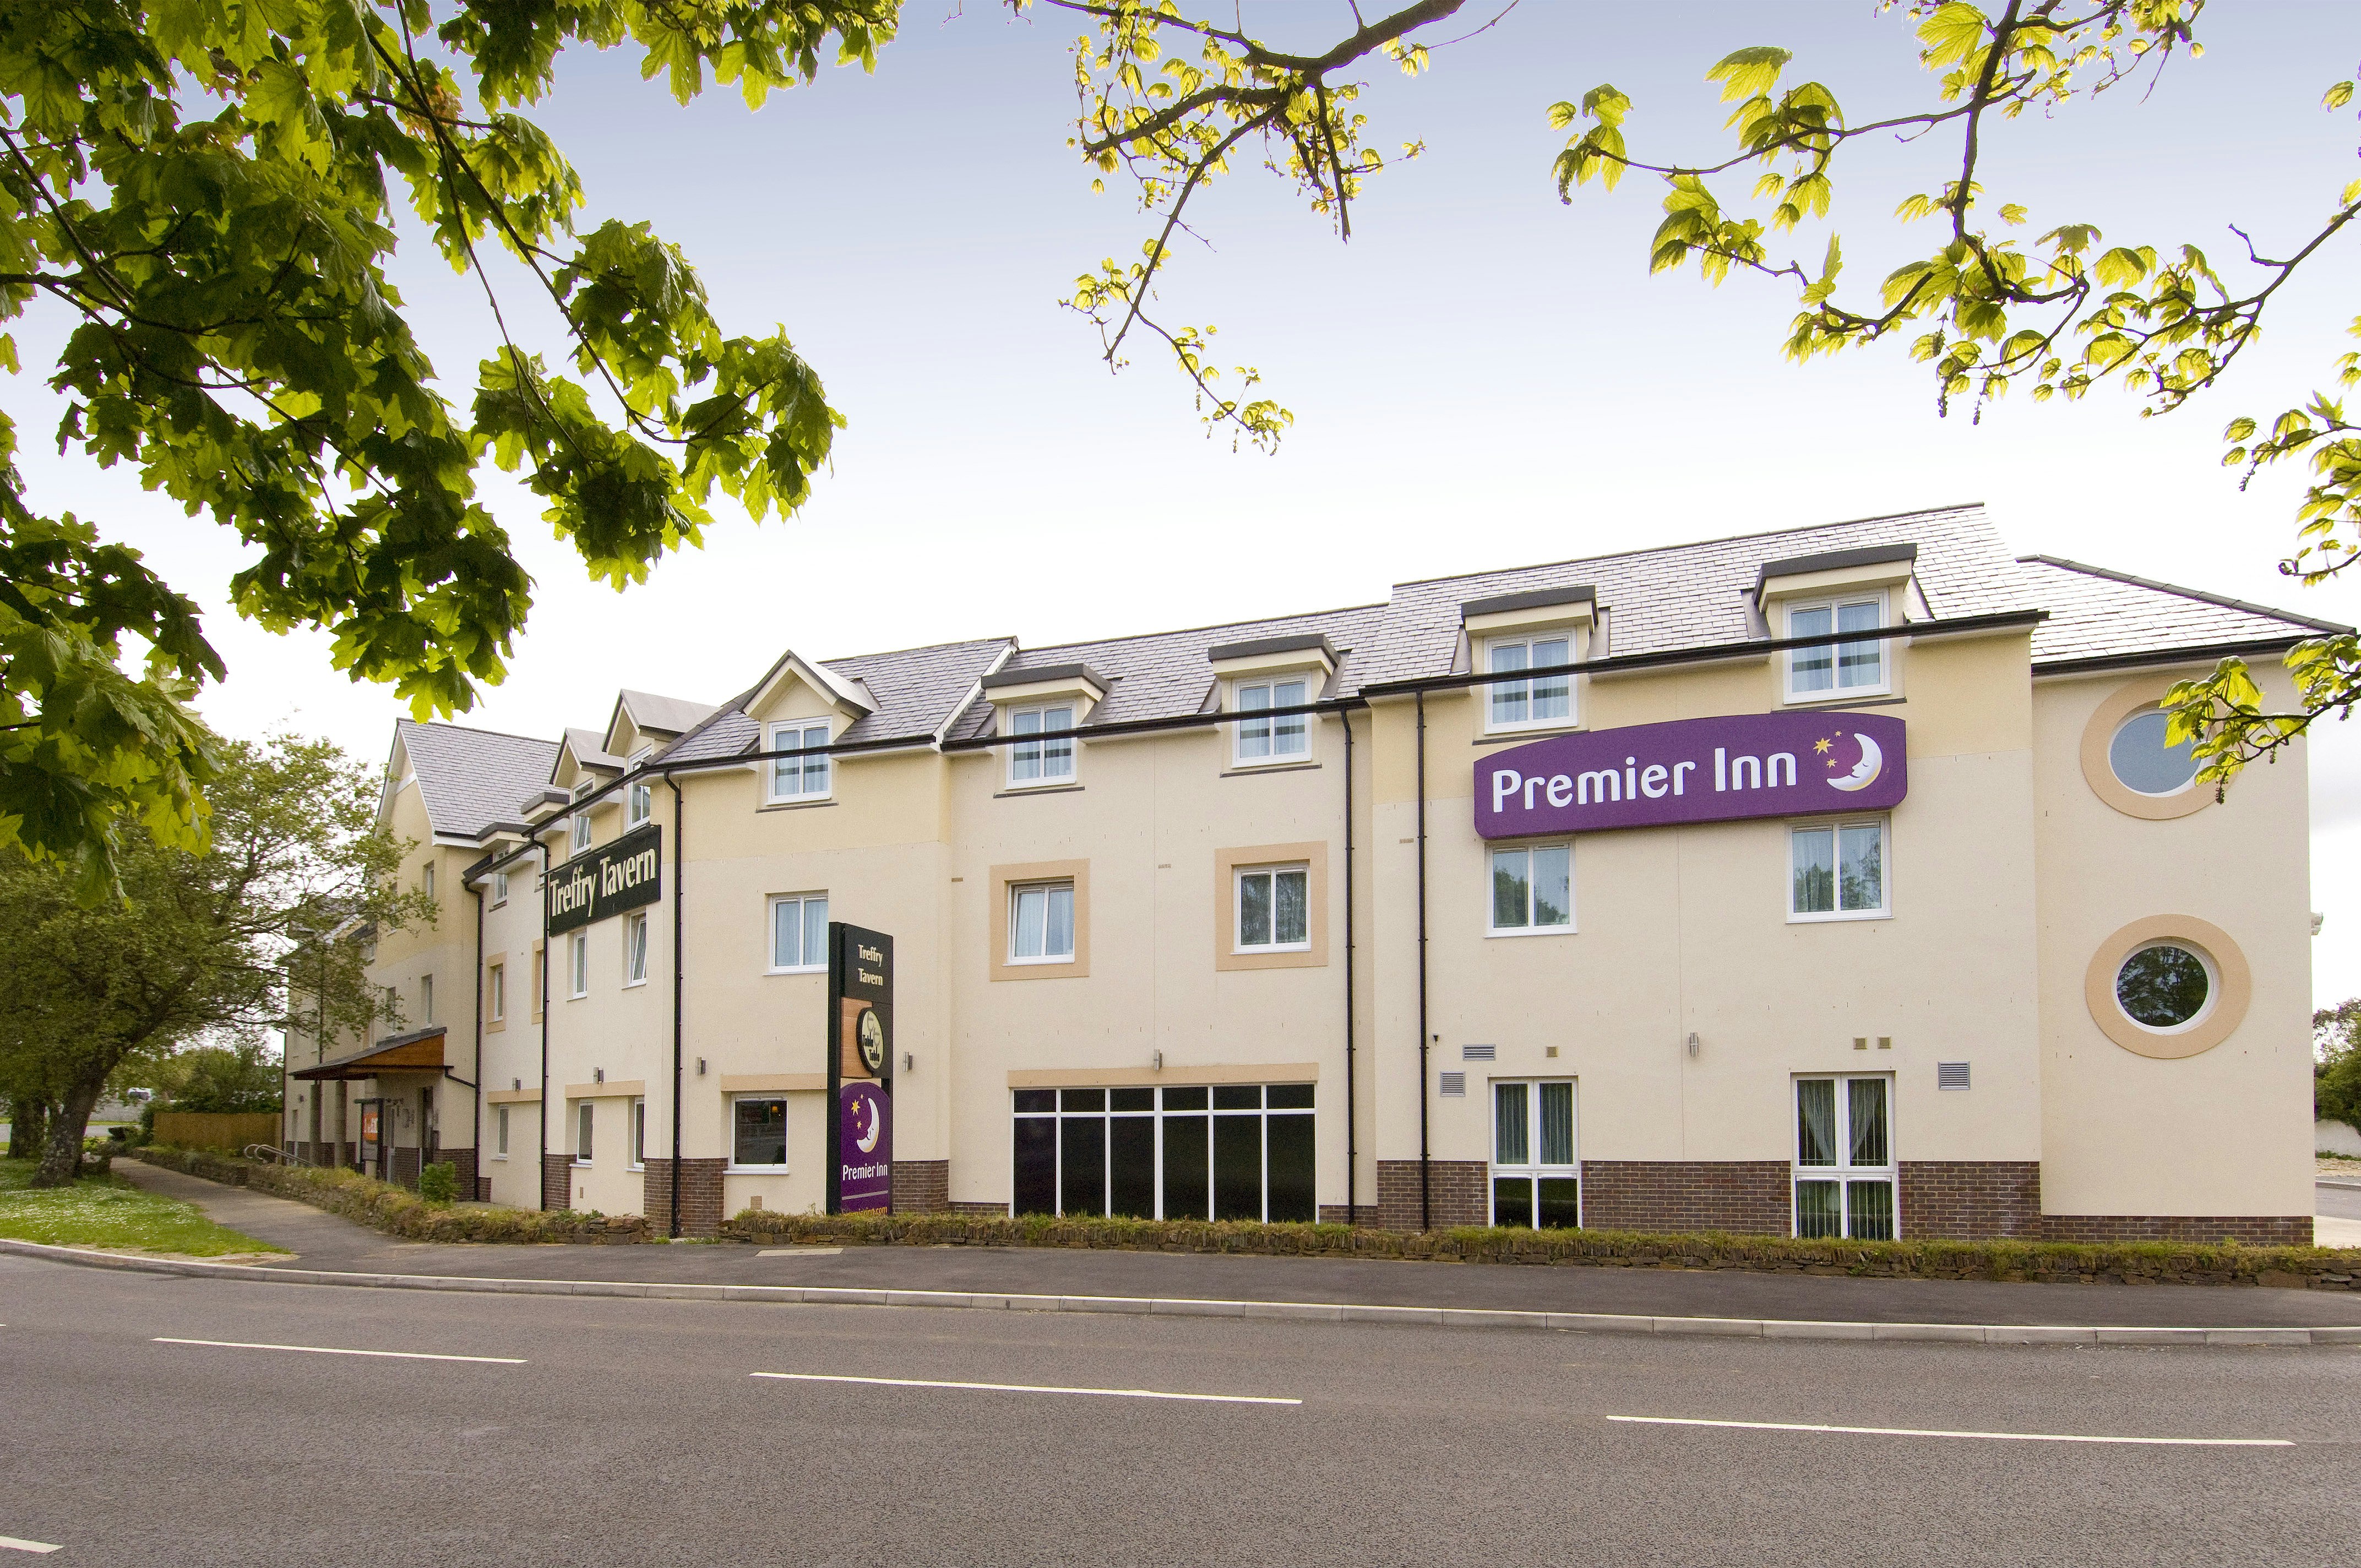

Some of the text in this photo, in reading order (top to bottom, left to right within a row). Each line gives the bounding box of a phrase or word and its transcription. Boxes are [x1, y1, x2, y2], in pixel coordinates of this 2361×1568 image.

[1493, 747, 1797, 813] Premier Inn
[550, 848, 656, 917] Treffry Tavern
[857, 944, 883, 967] Treffry
[857, 968, 883, 987] Tavern
[842, 1162, 888, 1181] Premier Inn
